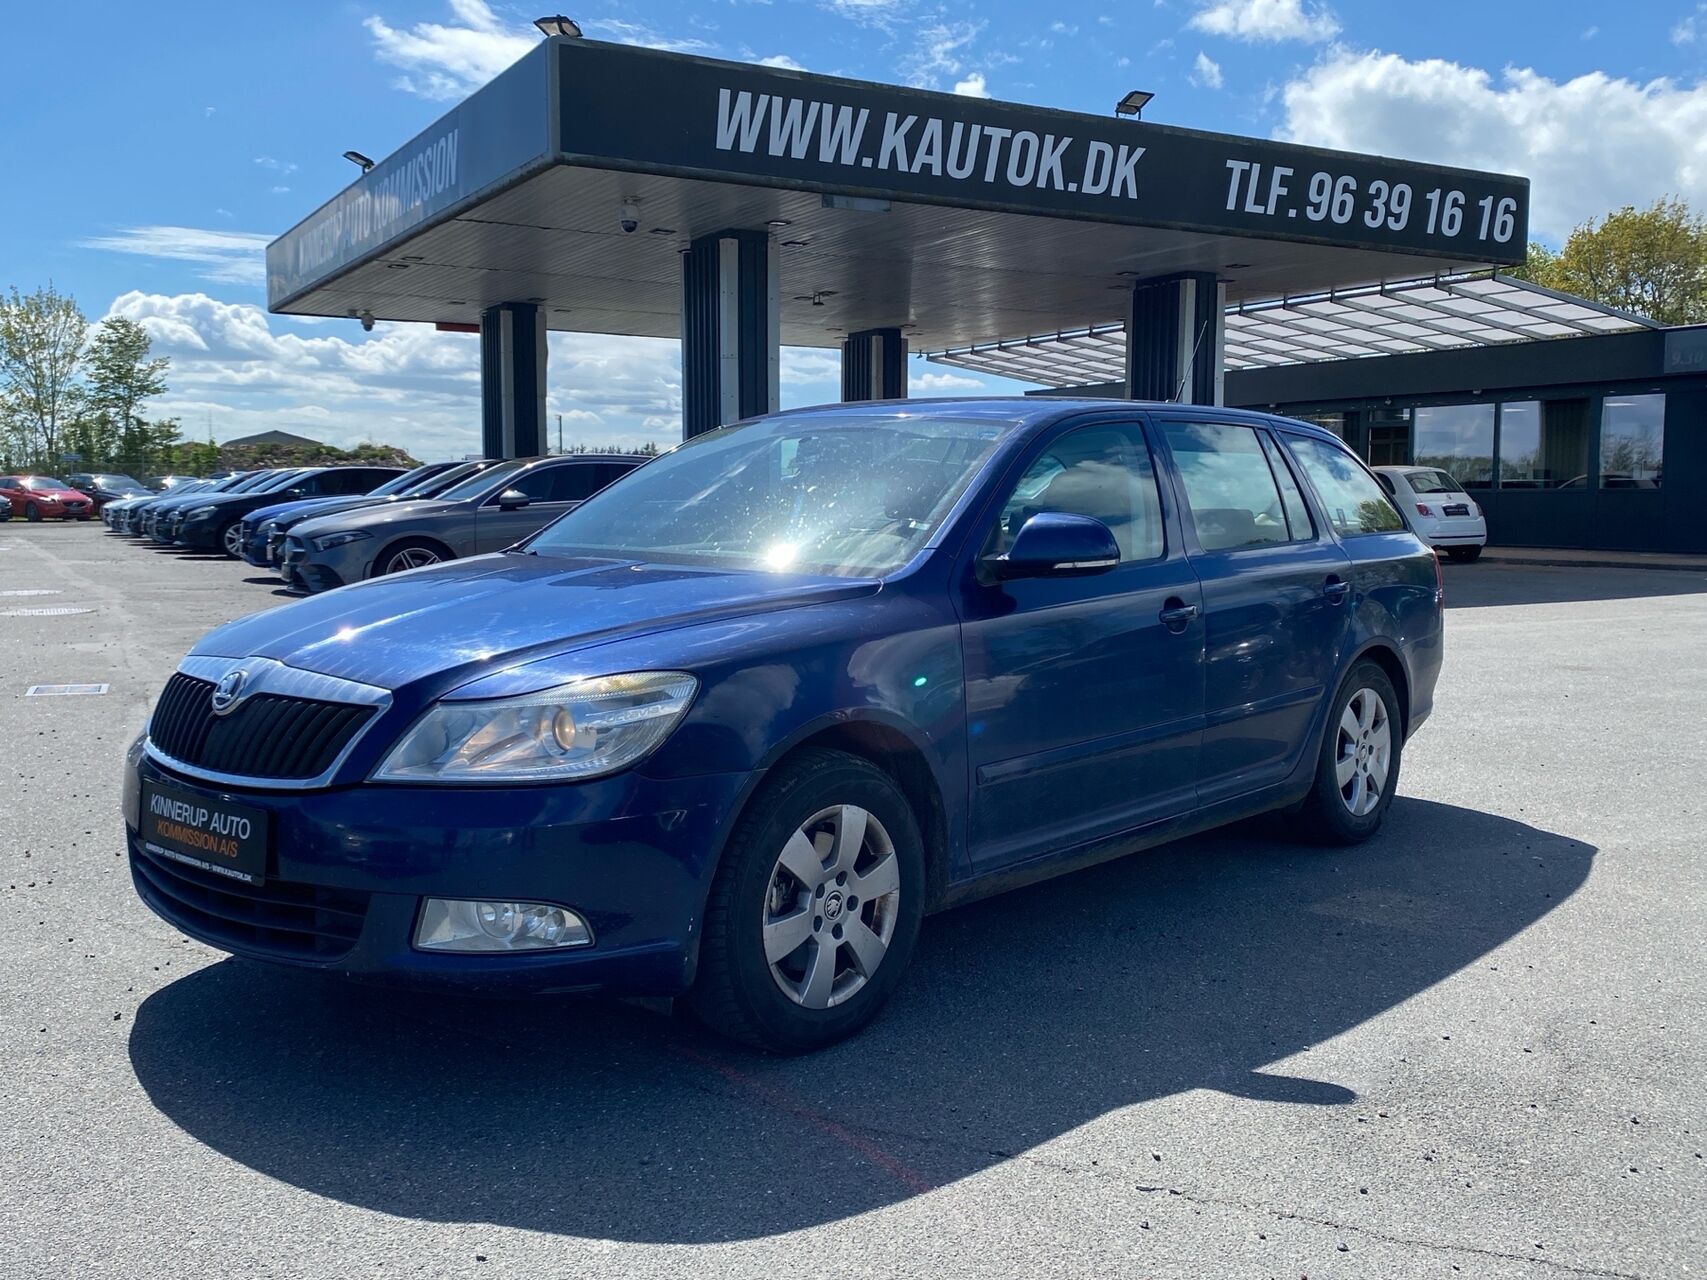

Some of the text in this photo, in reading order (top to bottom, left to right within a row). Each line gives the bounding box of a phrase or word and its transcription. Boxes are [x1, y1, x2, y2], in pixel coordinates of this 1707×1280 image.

[373, 129, 459, 232] KOMMISSION
[715, 88, 1146, 199] WWW.KAUTOK.DK
[1225, 159, 1517, 243] TLF. 96 39 16 16
[150, 793, 250, 840] KINNERUP AUTO
[157, 820, 218, 850] KOMMISSION
[219, 836, 239, 858] A/S
